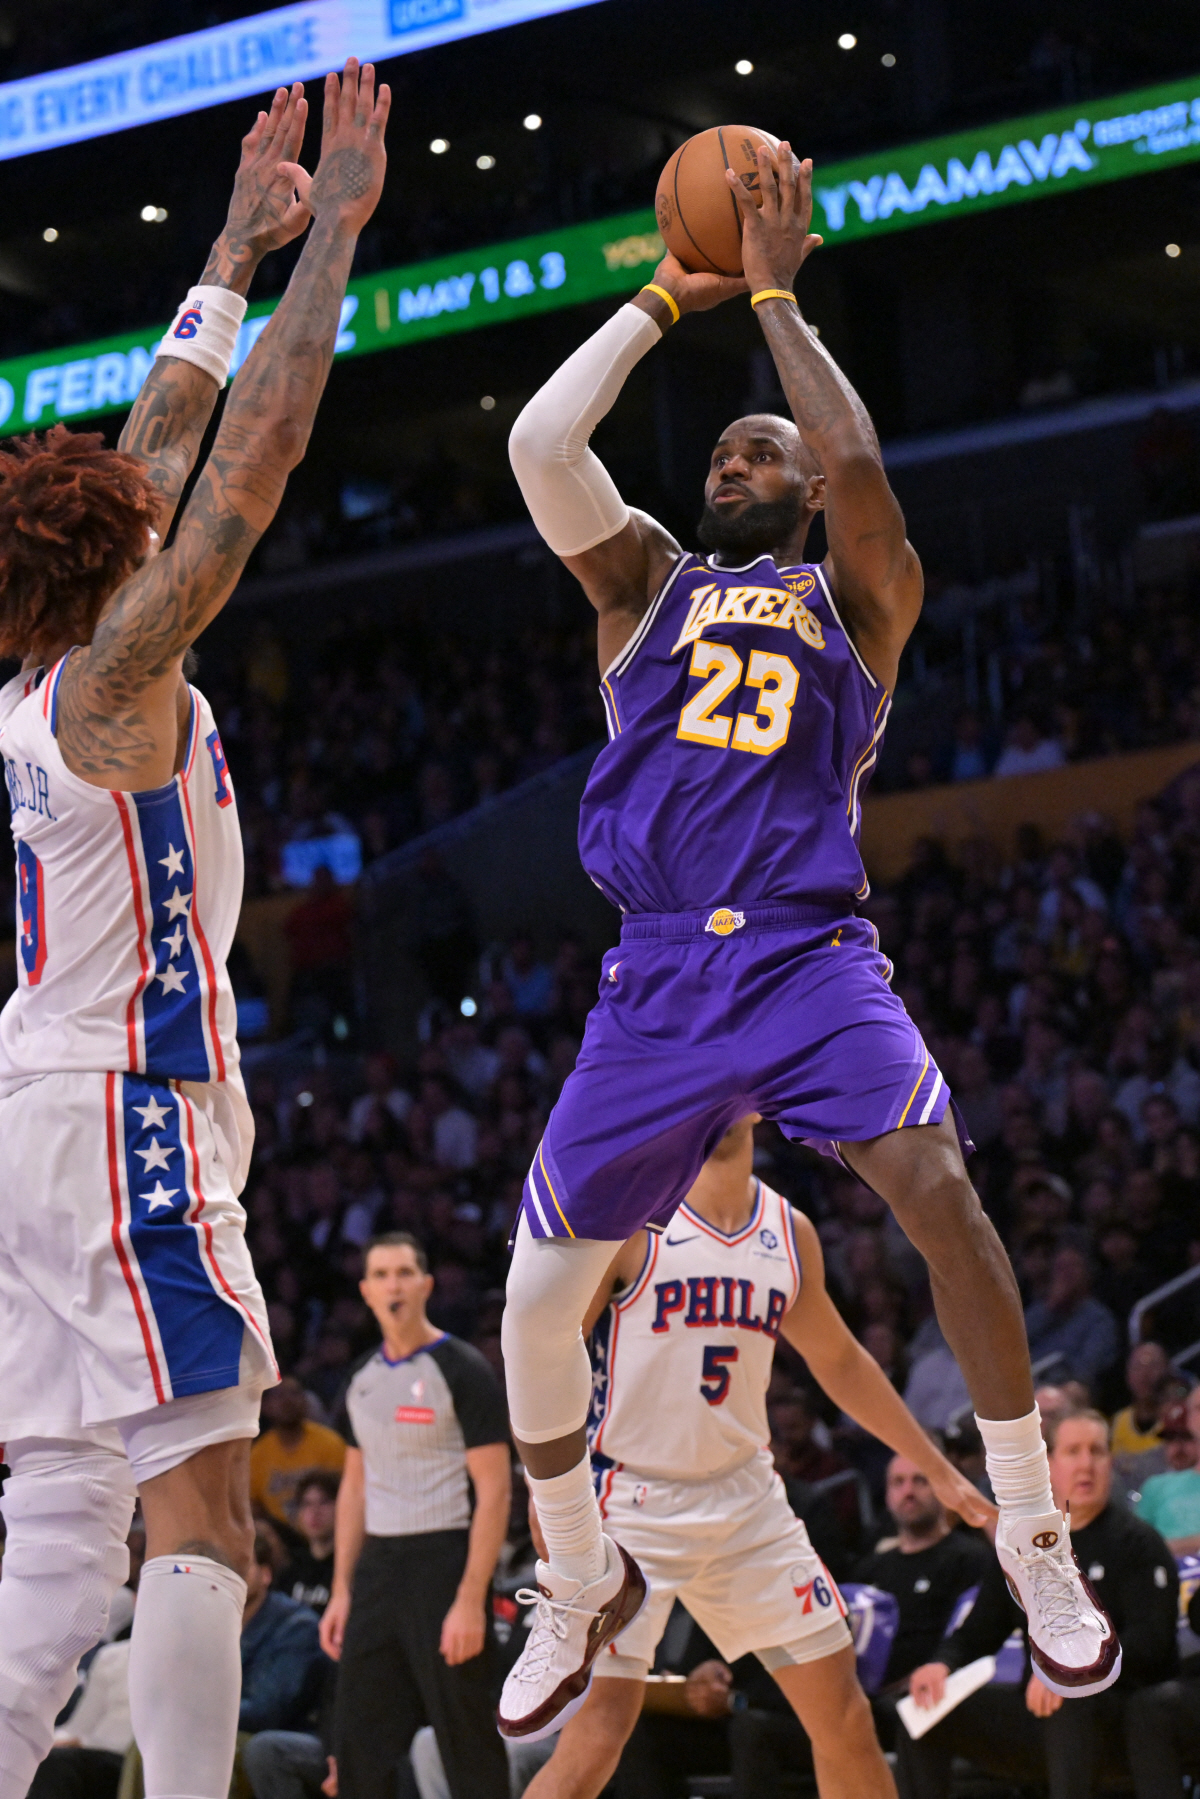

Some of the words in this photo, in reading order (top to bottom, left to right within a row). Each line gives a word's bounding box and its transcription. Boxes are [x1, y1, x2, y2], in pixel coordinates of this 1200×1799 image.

[34, 70, 128, 133] EVERY
[140, 18, 316, 106] CHALLENGE
[398, 272, 476, 323] MAY
[480, 267, 499, 302] 1
[539, 252, 566, 289] 3
[670, 583, 826, 655] LAKERS
[676, 639, 800, 756] 23
[705, 914, 744, 931] LAKERS
[652, 1276, 788, 1341] PHILA
[700, 1346, 739, 1406] 5
[793, 1576, 832, 1615] 76
